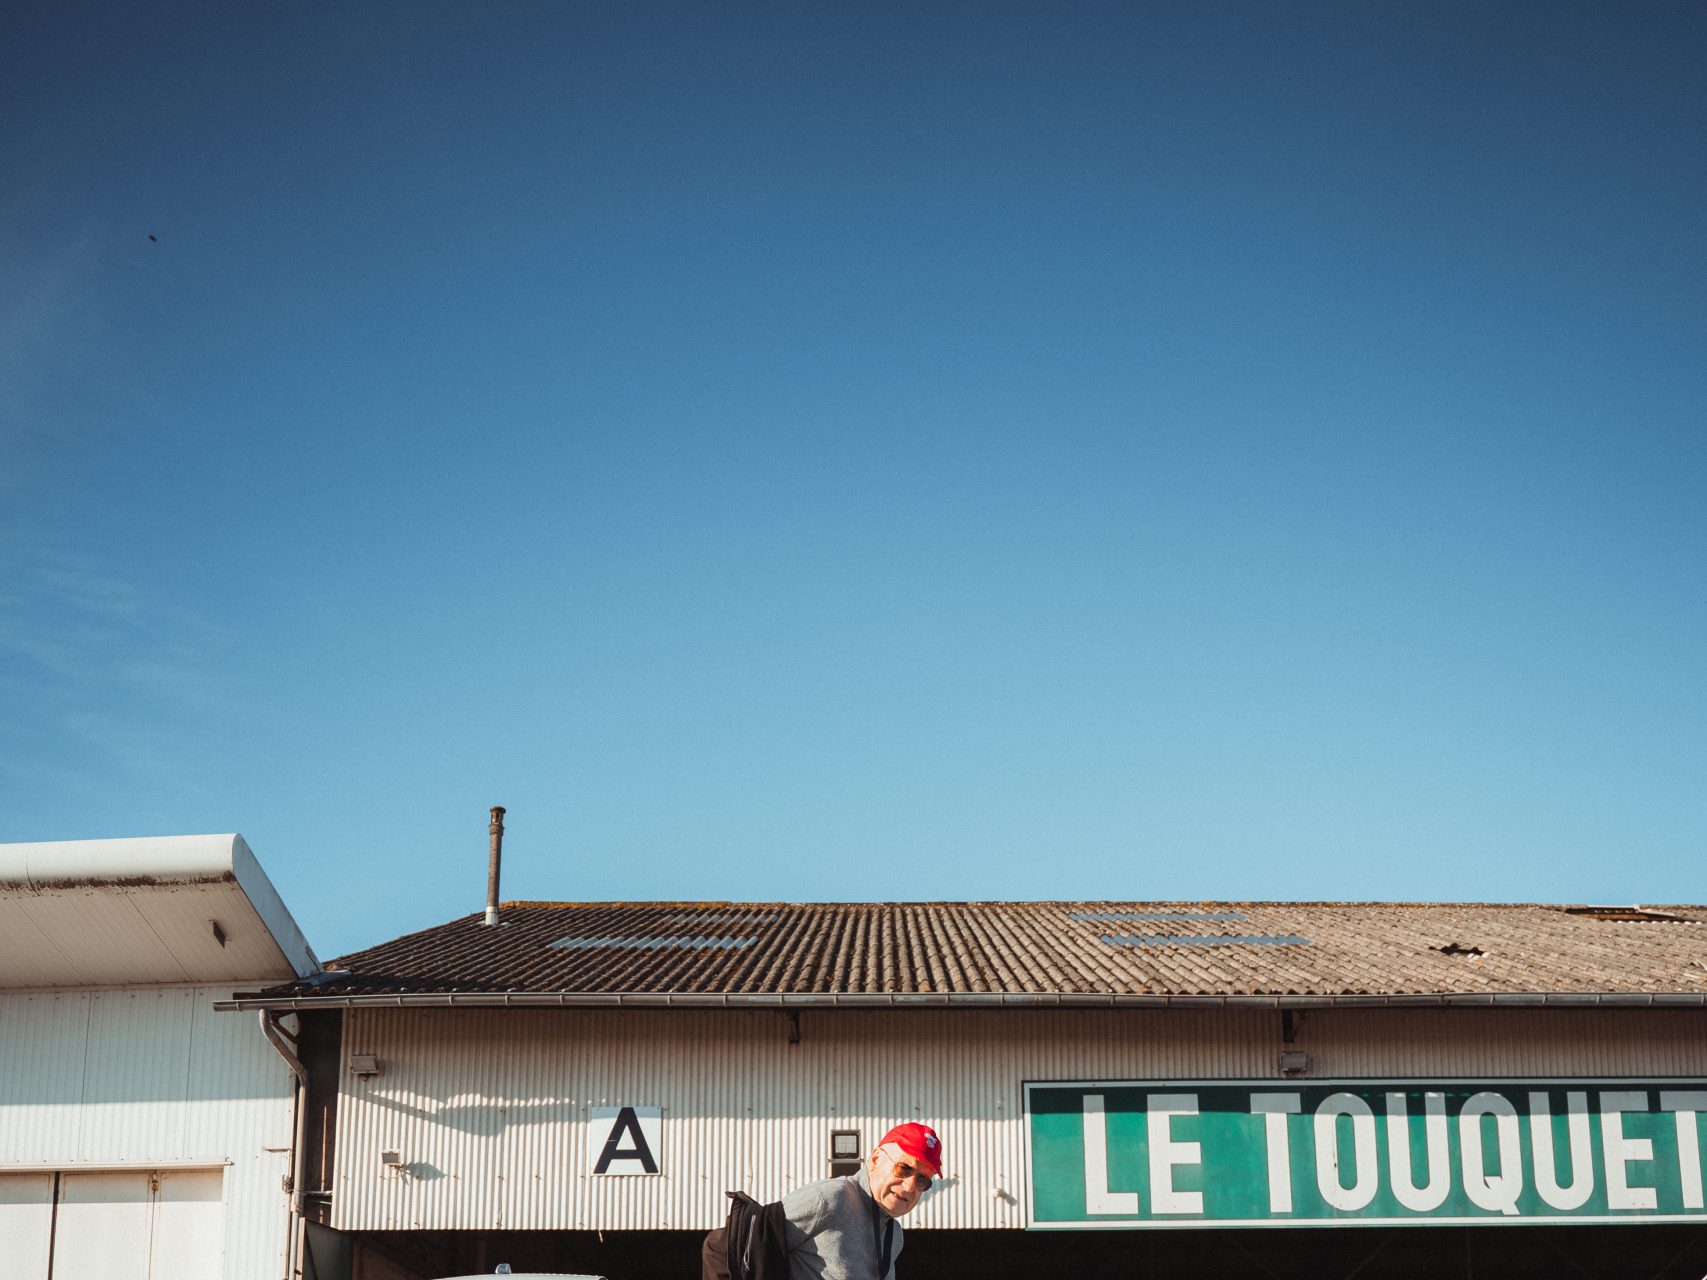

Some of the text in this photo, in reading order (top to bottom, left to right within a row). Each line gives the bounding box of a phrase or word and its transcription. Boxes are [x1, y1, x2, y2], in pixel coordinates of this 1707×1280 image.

[593, 1106, 659, 1174] A
[1082, 1091, 1707, 1216] LE TOUQUET
